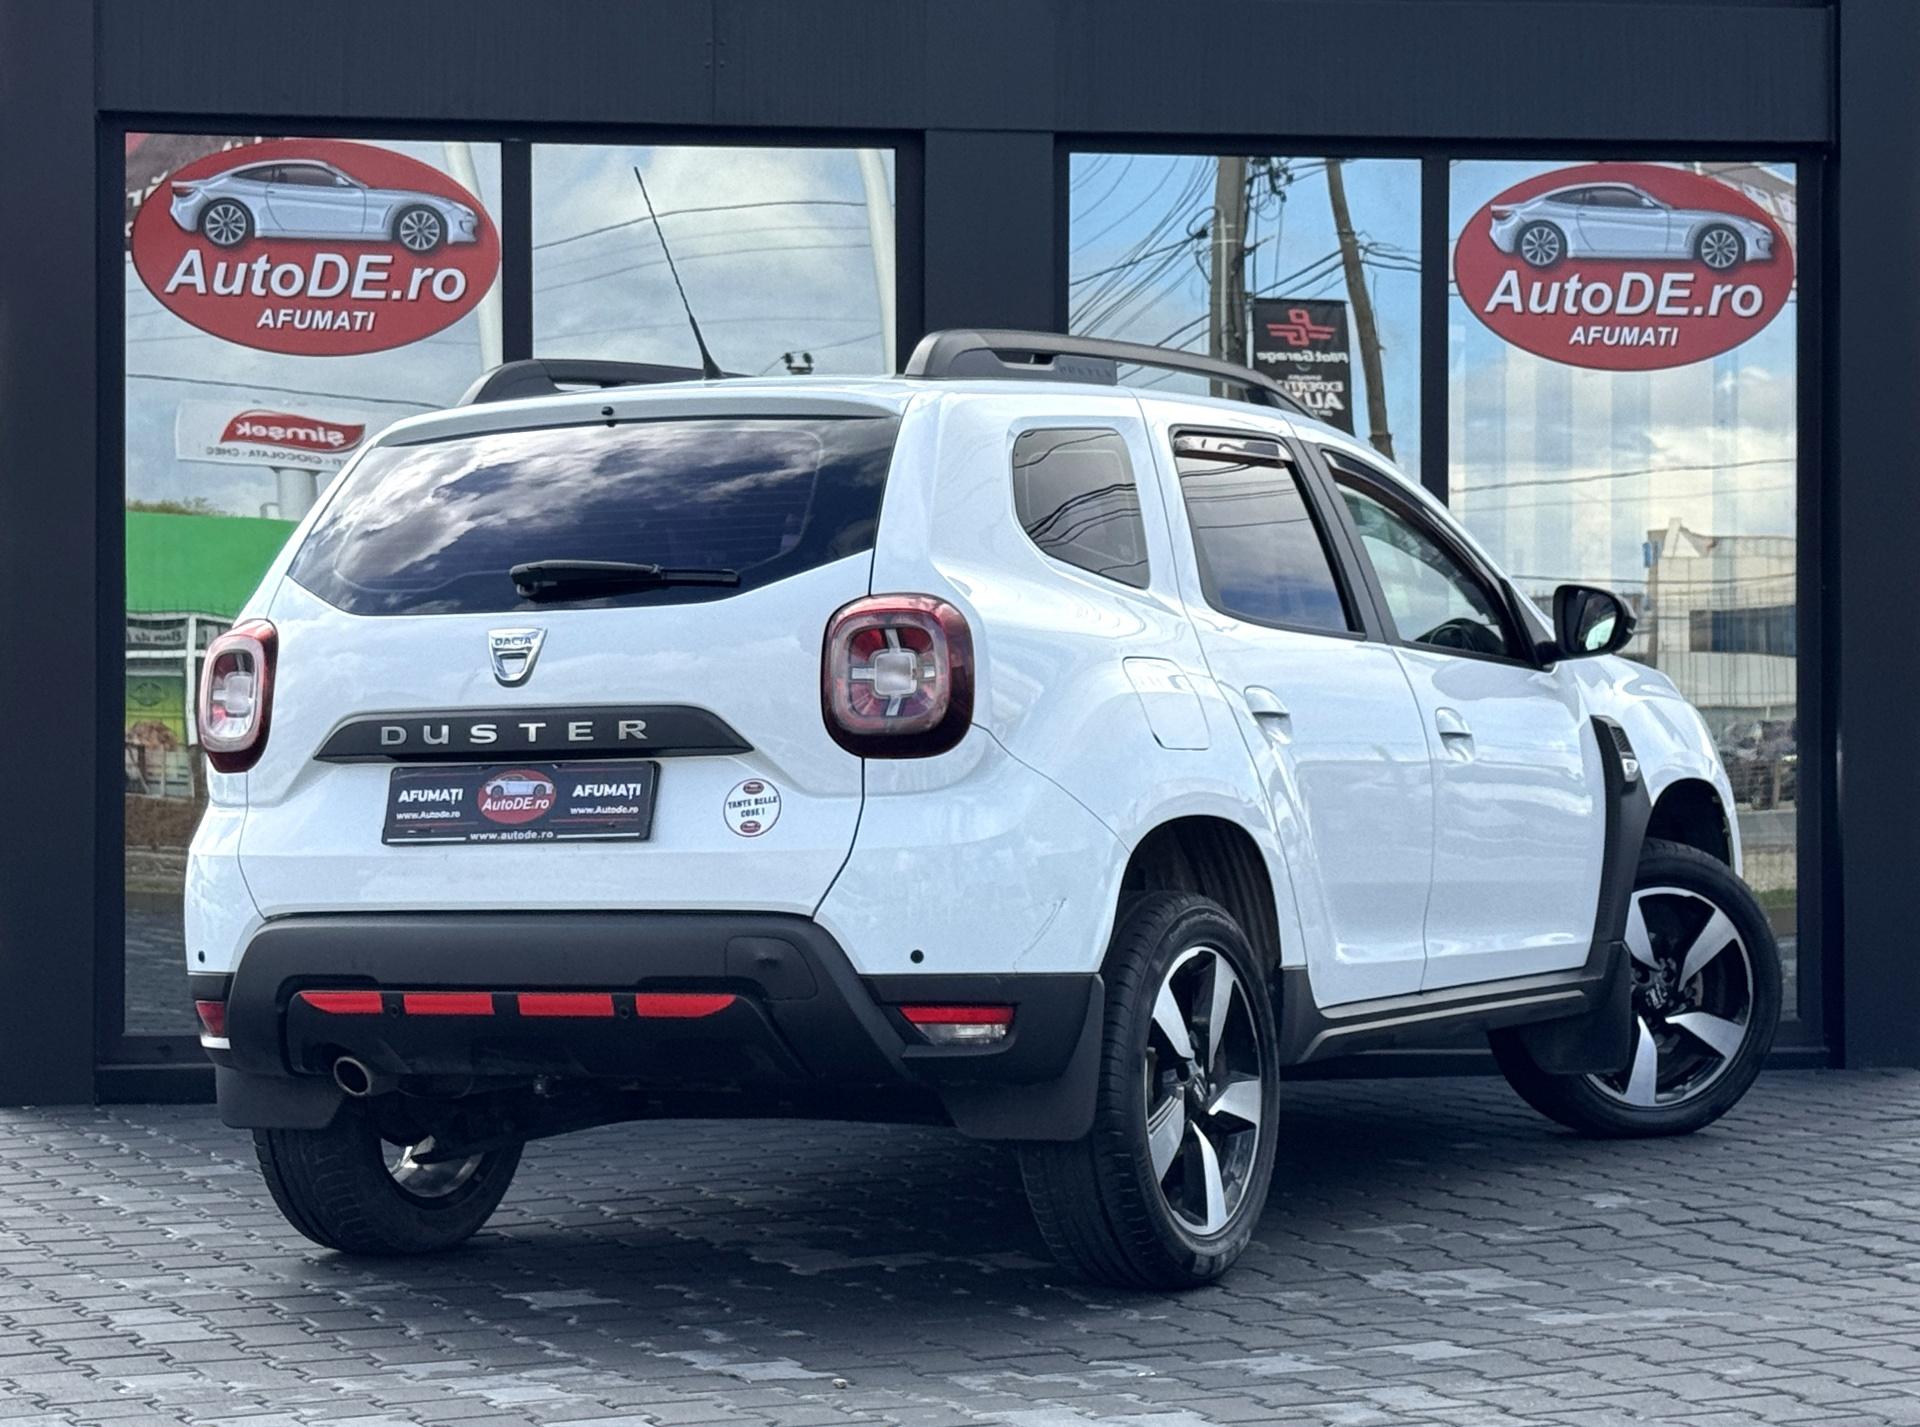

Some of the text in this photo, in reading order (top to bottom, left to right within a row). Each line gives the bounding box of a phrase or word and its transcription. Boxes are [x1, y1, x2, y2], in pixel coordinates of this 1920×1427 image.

[165, 249, 467, 302] AutoDE.ro
[1484, 270, 1765, 319] AutoDE.ro
[256, 308, 376, 333] AFUMATI
[1568, 325, 1679, 348] AFUMATI
[494, 636, 532, 646] DACIA
[381, 720, 648, 746] DUSTER
[481, 797, 550, 812] AutoDE.ro
[469, 830, 554, 841] www.autode.ro
